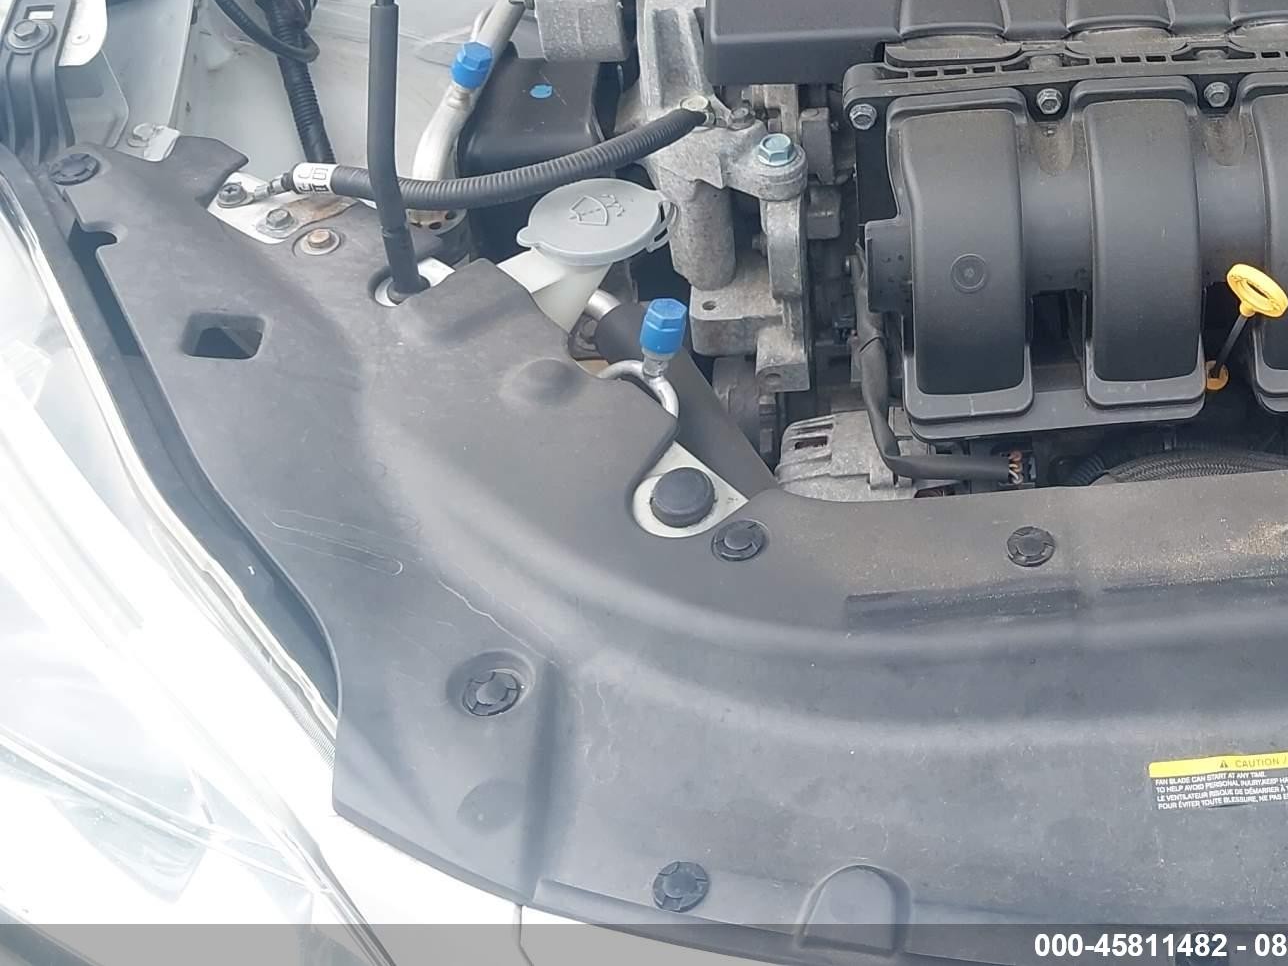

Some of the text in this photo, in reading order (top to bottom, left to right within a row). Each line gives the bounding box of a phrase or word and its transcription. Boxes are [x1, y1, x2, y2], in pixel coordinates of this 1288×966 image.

[1235, 757, 1280, 769] CAUTION
[1169, 777, 1191, 785] BLADE
[1191, 775, 1206, 783] CAN
[1206, 773, 1226, 782] START
[1227, 772, 1236, 780] AT
[1156, 786, 1166, 794] TO
[1166, 785, 1183, 793] HELP
[1184, 783, 1204, 792] AVOID
[1205, 780, 1240, 790] PERSONAL
[1166, 791, 1209, 802] VENTILATEUR
[1209, 789, 1233, 797] RISQUE
[1244, 785, 1280, 795] DÉMARRER
[1158, 802, 1178, 810] POUR
[1178, 800, 1201, 809] ÉVITER
[1201, 798, 1222, 806] TOUTE
[1269, 793, 1282, 801] PAS
